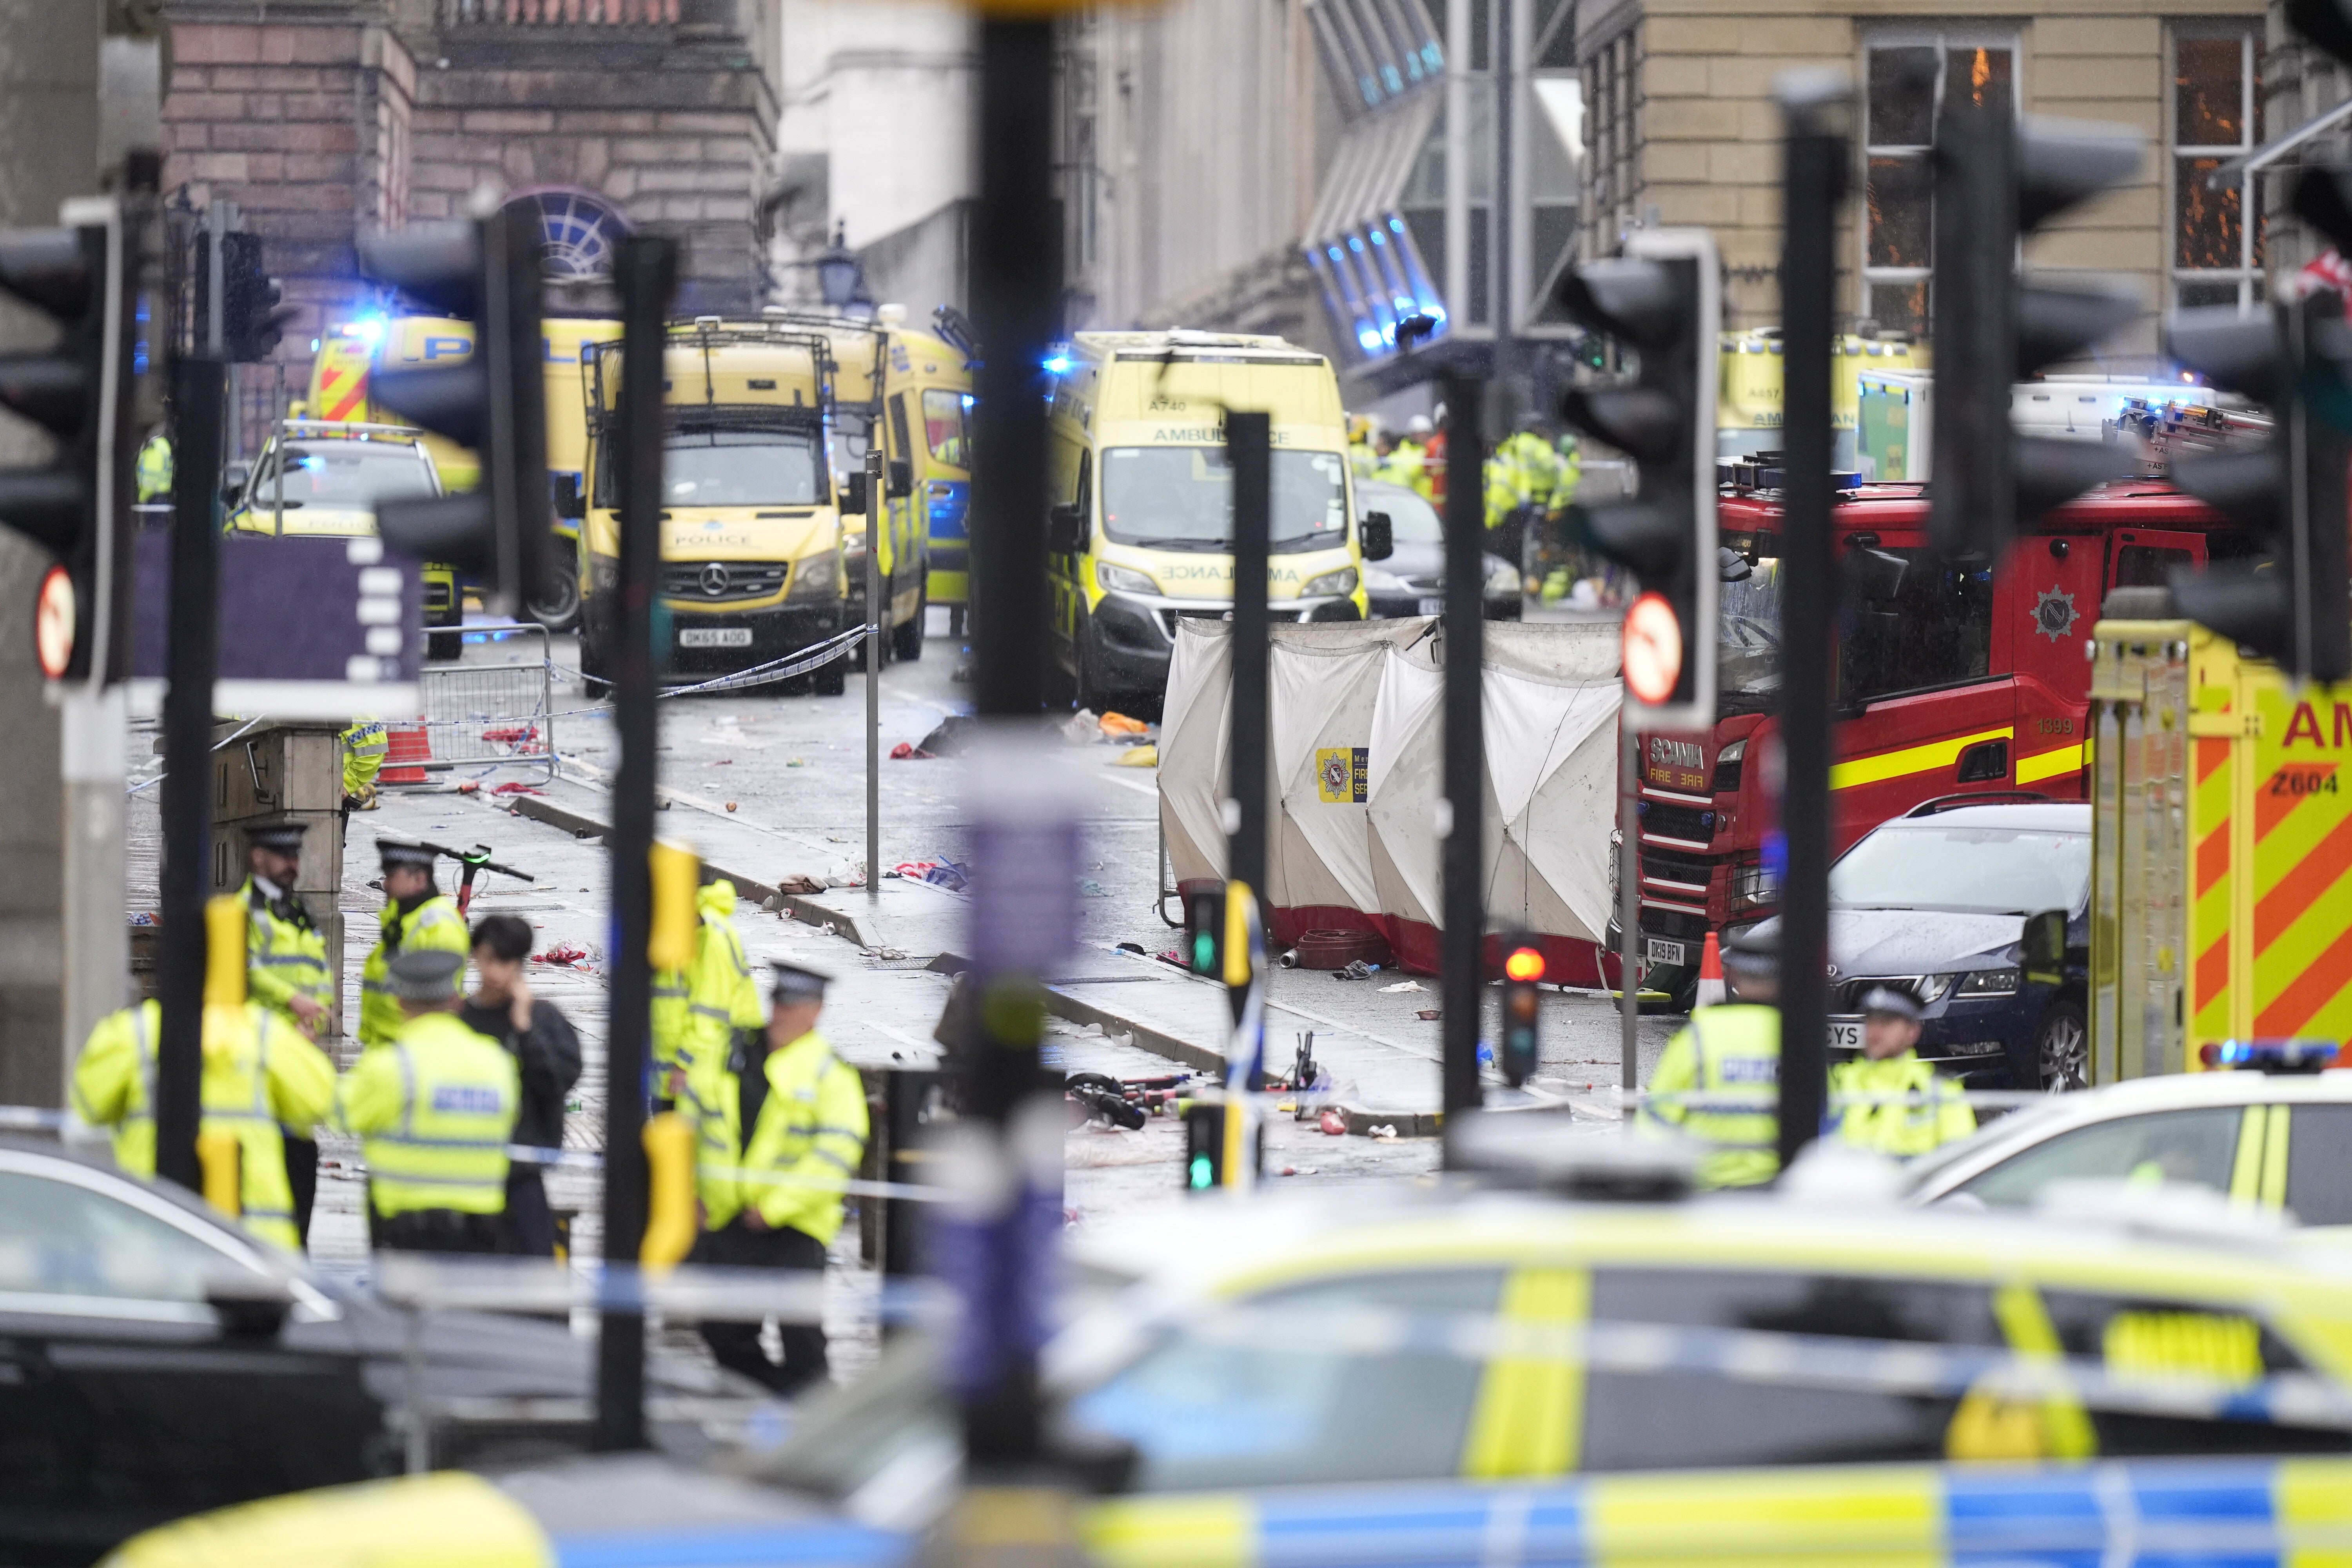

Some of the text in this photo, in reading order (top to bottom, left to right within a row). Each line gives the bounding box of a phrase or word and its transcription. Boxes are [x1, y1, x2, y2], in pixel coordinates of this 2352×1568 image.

[1148, 400, 1186, 412] A740
[1154, 428, 1290, 445] AMBULCE
[675, 534, 751, 545] POLICE
[2036, 717, 2074, 734] 1399
[1650, 737, 1704, 769] SCANIA
[1650, 768, 1671, 783] FIRE
[1651, 941, 1680, 962] DK19 BFN
